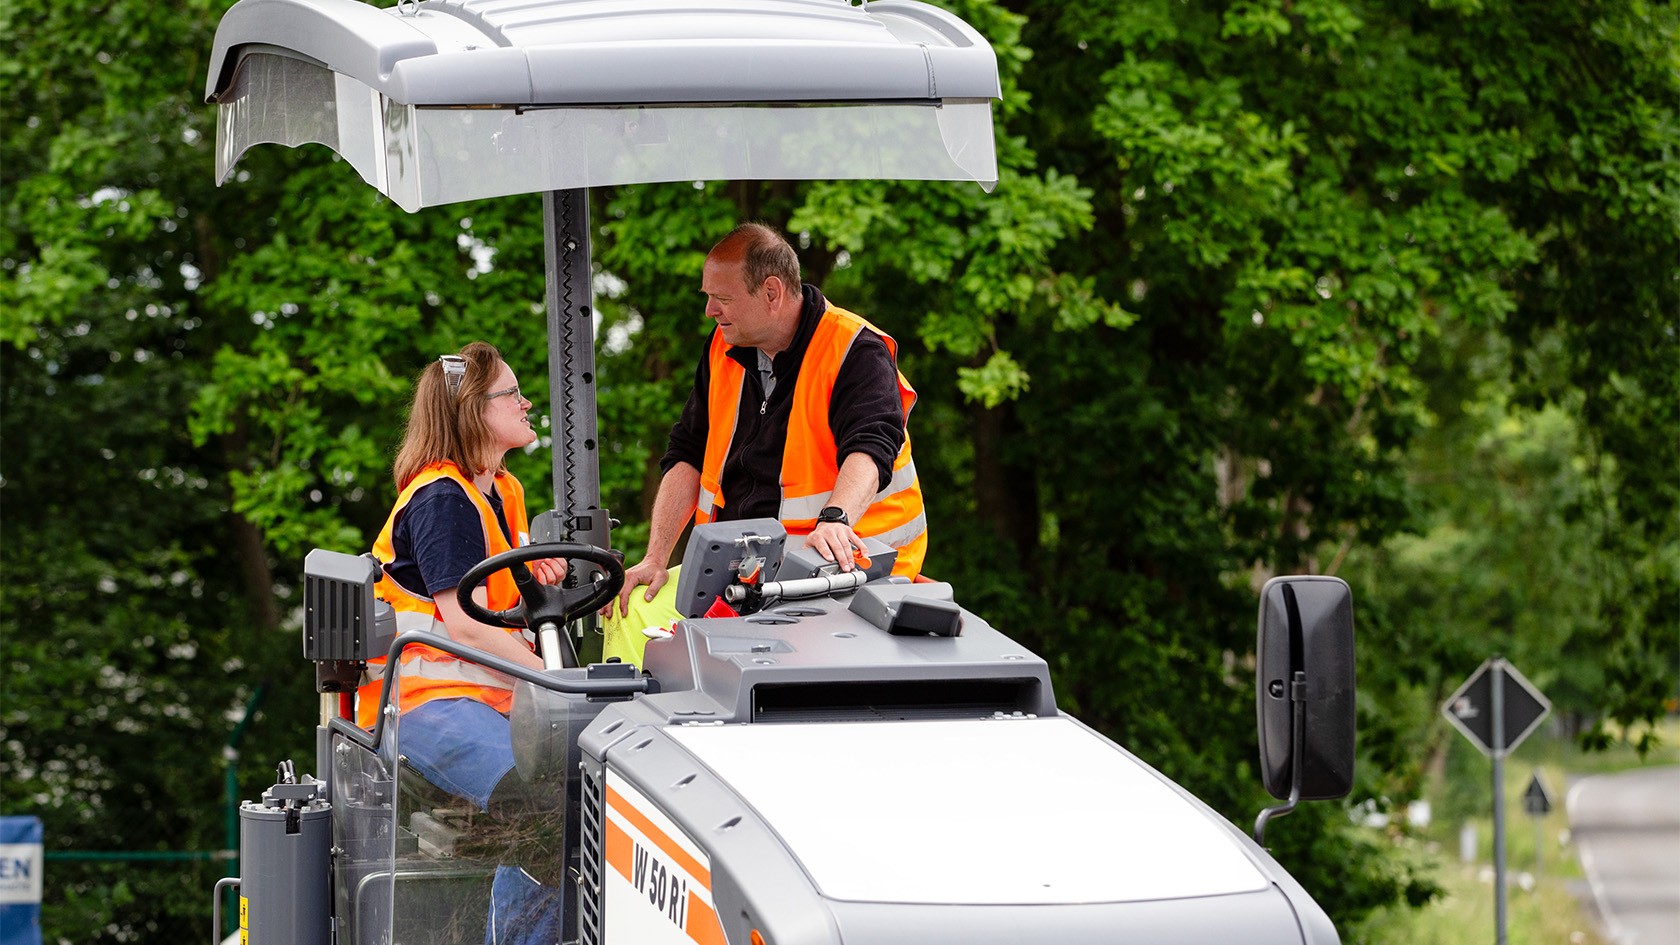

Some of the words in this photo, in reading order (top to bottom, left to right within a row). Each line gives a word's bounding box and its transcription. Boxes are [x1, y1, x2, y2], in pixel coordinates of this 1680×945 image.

[635, 842, 648, 894] W
[649, 857, 667, 912] 50
[668, 874, 686, 930] Ri
